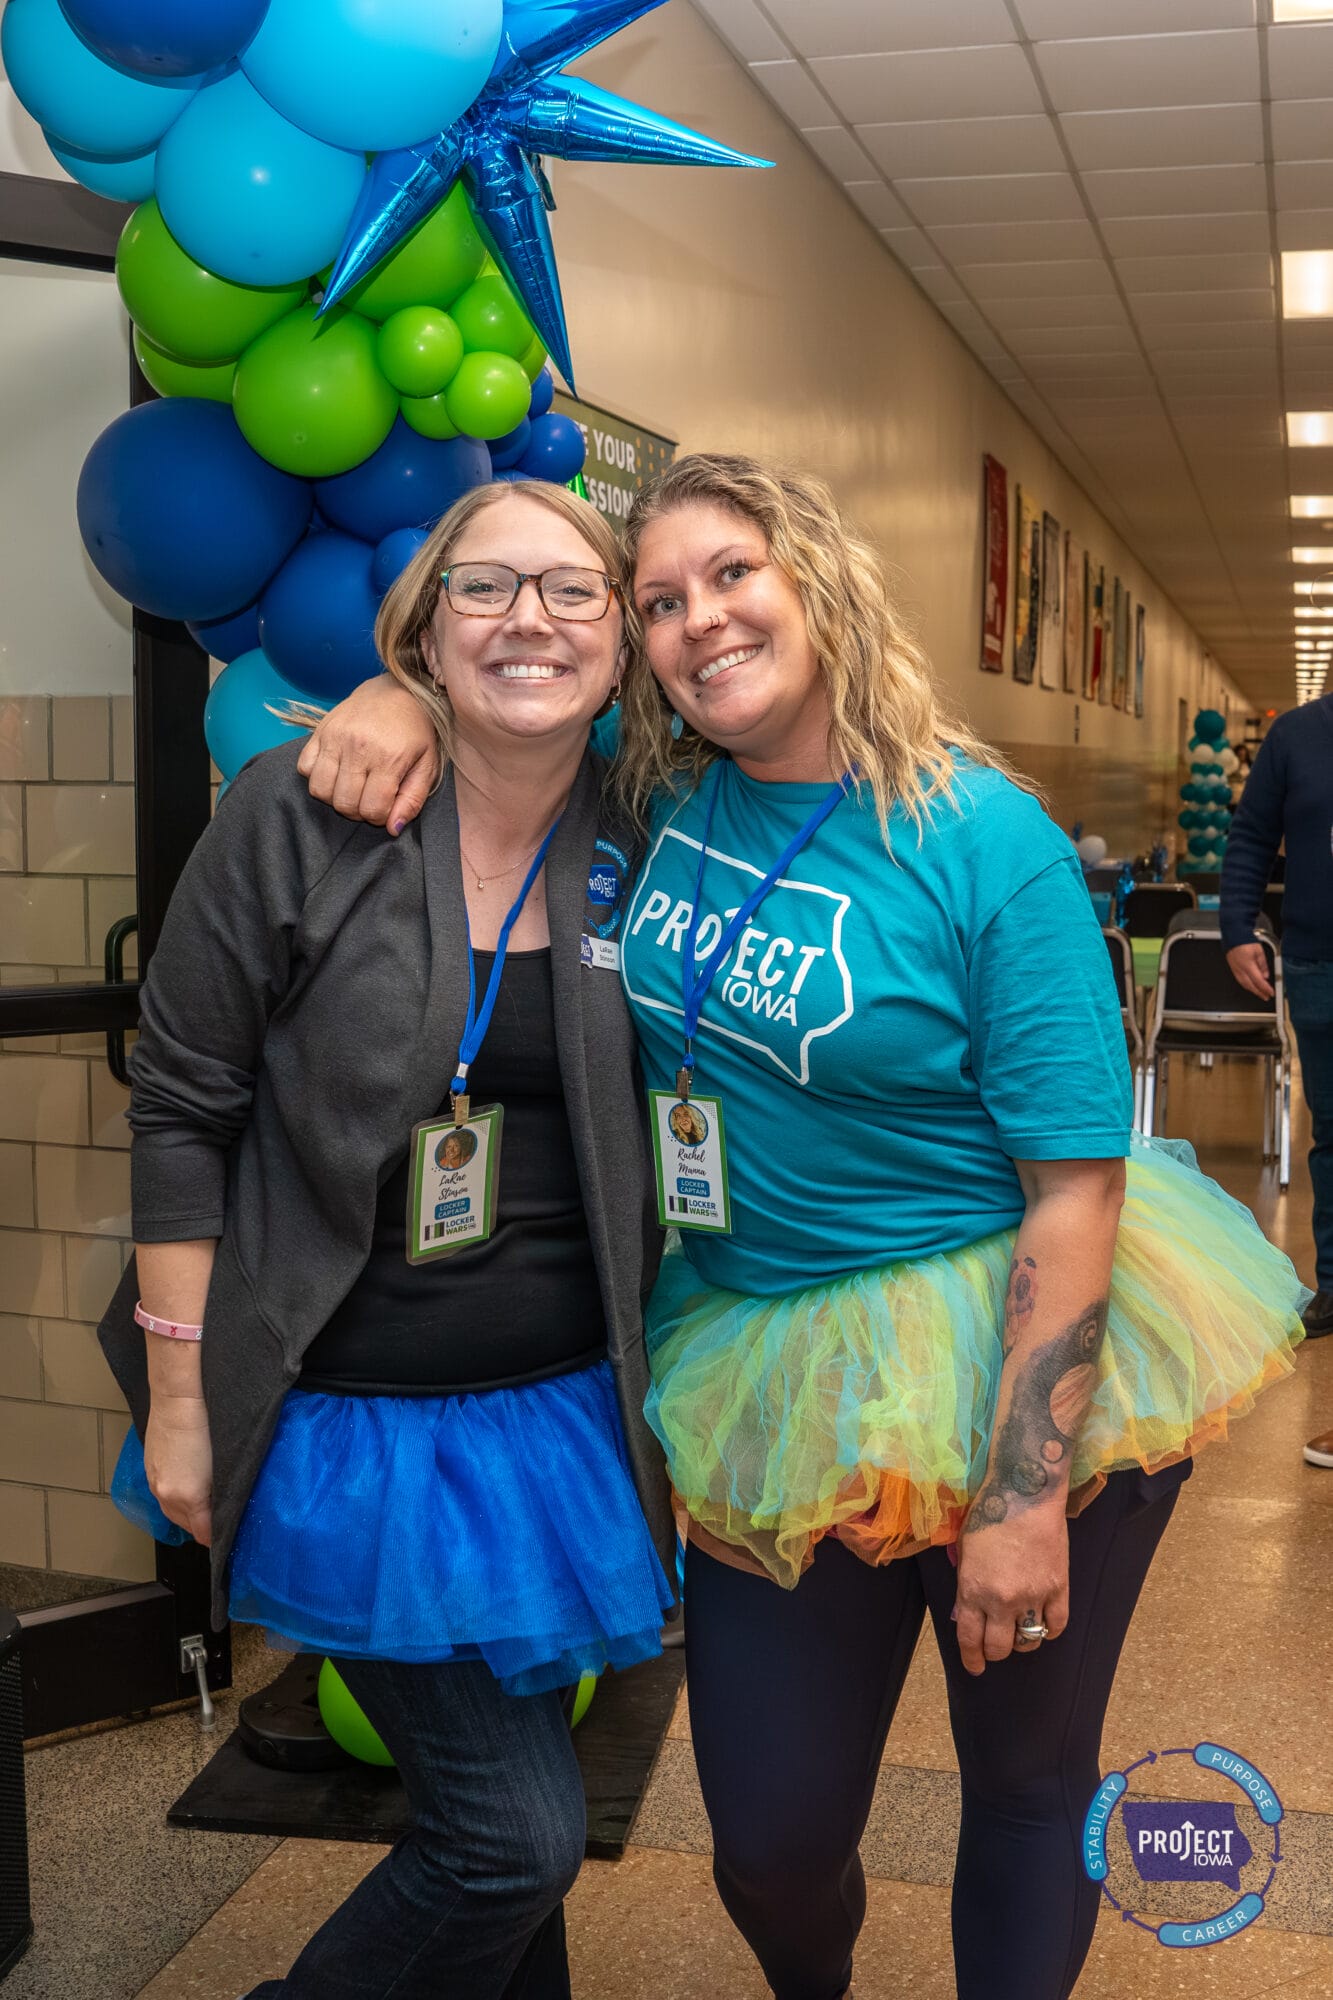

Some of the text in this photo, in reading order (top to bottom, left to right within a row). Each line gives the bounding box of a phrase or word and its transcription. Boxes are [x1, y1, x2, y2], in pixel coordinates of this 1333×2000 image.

[592, 429, 636, 474] YOUR
[589, 873, 616, 893] ROJECT
[721, 976, 798, 1027] IOWA
[677, 1146, 706, 1163] Rachel
[439, 1172, 467, 1187] LaRae
[681, 1180, 705, 1188] LOCKER
[680, 1186, 707, 1196] CAPTAIN
[440, 1200, 466, 1211] LOCKER
[688, 1199, 717, 1210] LOCKER
[438, 1206, 467, 1218] CAPTAIN
[689, 1206, 711, 1217] WARS
[446, 1216, 475, 1228] LOCKER
[446, 1224, 468, 1236] WARS
